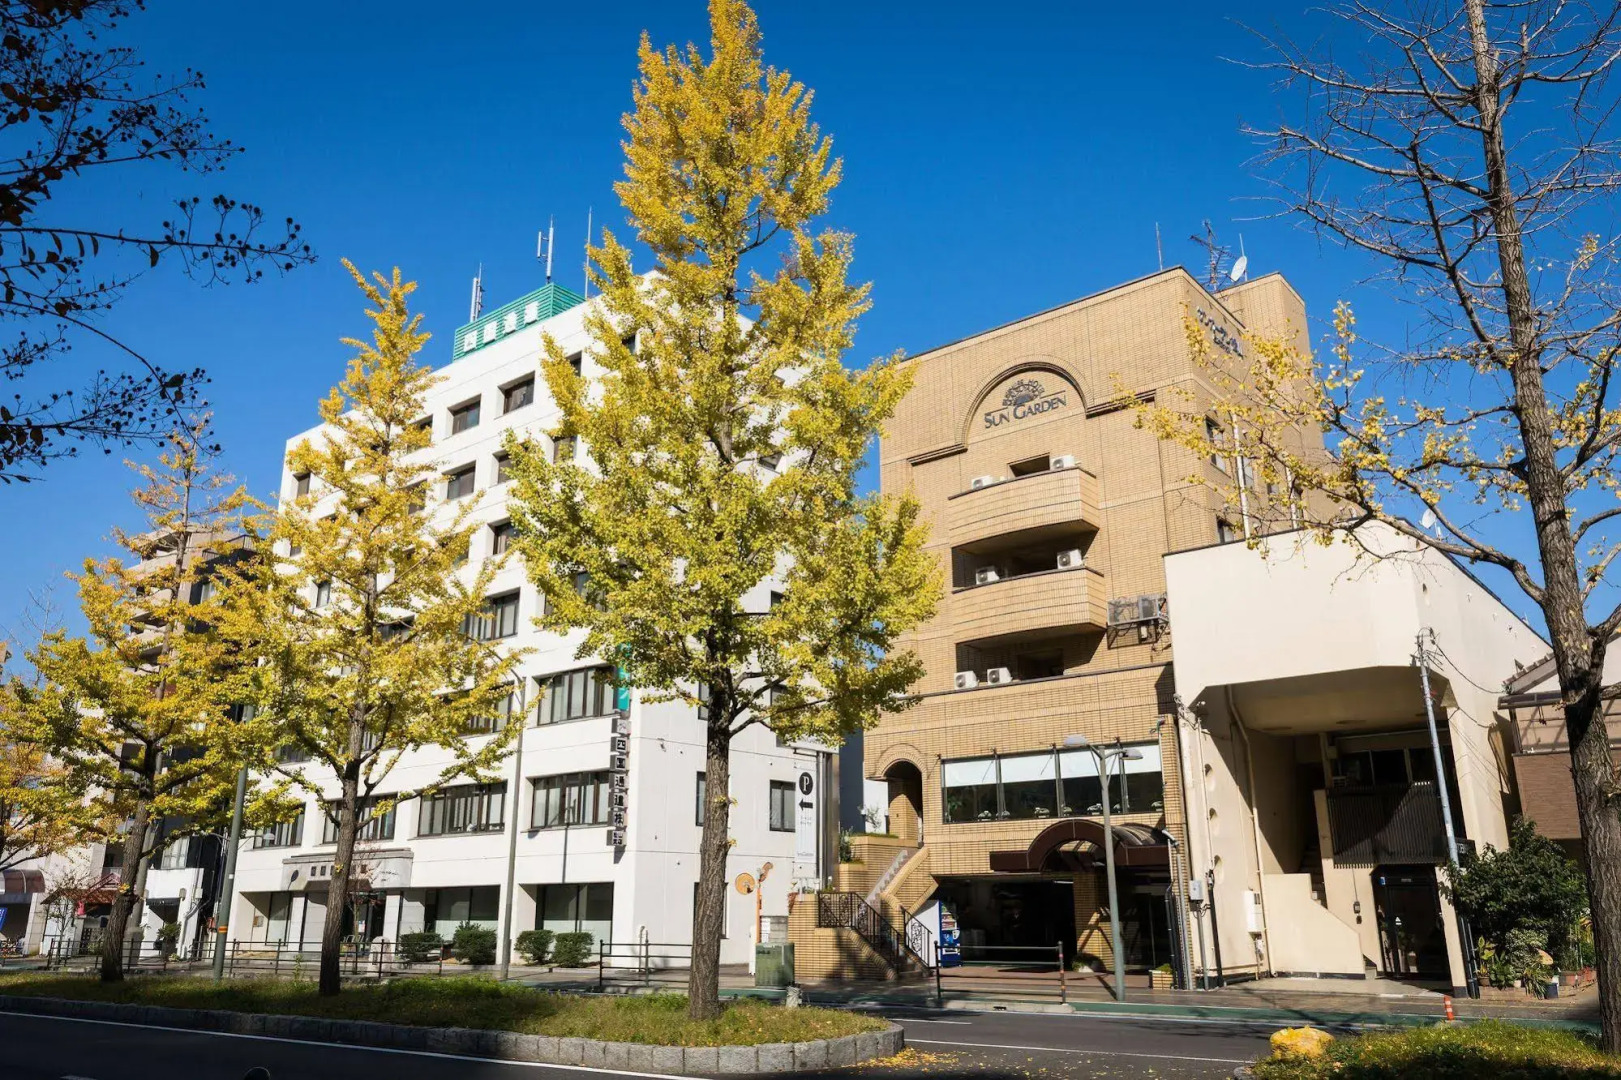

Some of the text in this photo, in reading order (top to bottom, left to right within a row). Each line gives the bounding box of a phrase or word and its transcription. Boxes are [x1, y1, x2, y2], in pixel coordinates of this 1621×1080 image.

[984, 395, 1067, 429] SUN GARDEN
[803, 776, 810, 792] P
